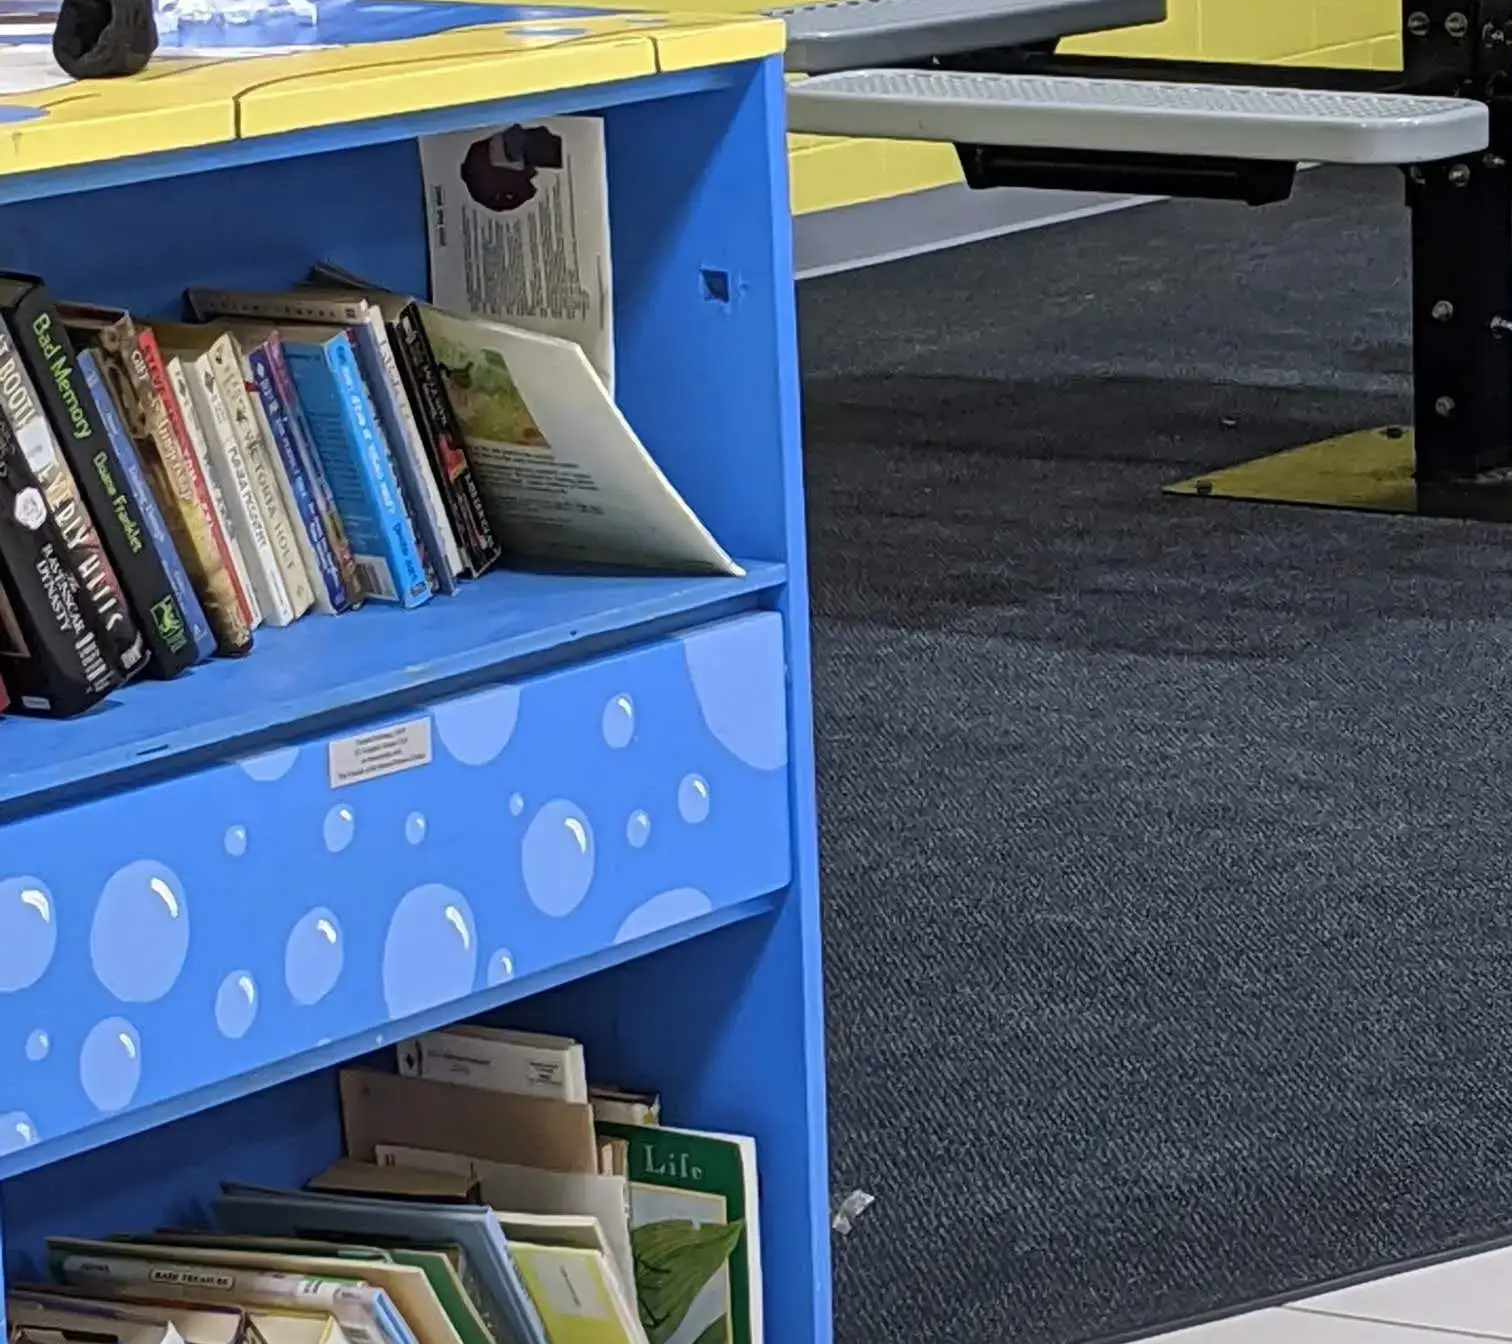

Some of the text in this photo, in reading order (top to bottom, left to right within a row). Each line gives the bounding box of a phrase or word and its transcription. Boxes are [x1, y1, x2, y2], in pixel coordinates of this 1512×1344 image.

[33, 312, 93, 440] Bad Memory
[35, 560, 73, 632] DYNASTY
[37, 460, 90, 550] EVERLY
[78, 556, 125, 632] HILLS
[644, 1144, 702, 1180] Life
